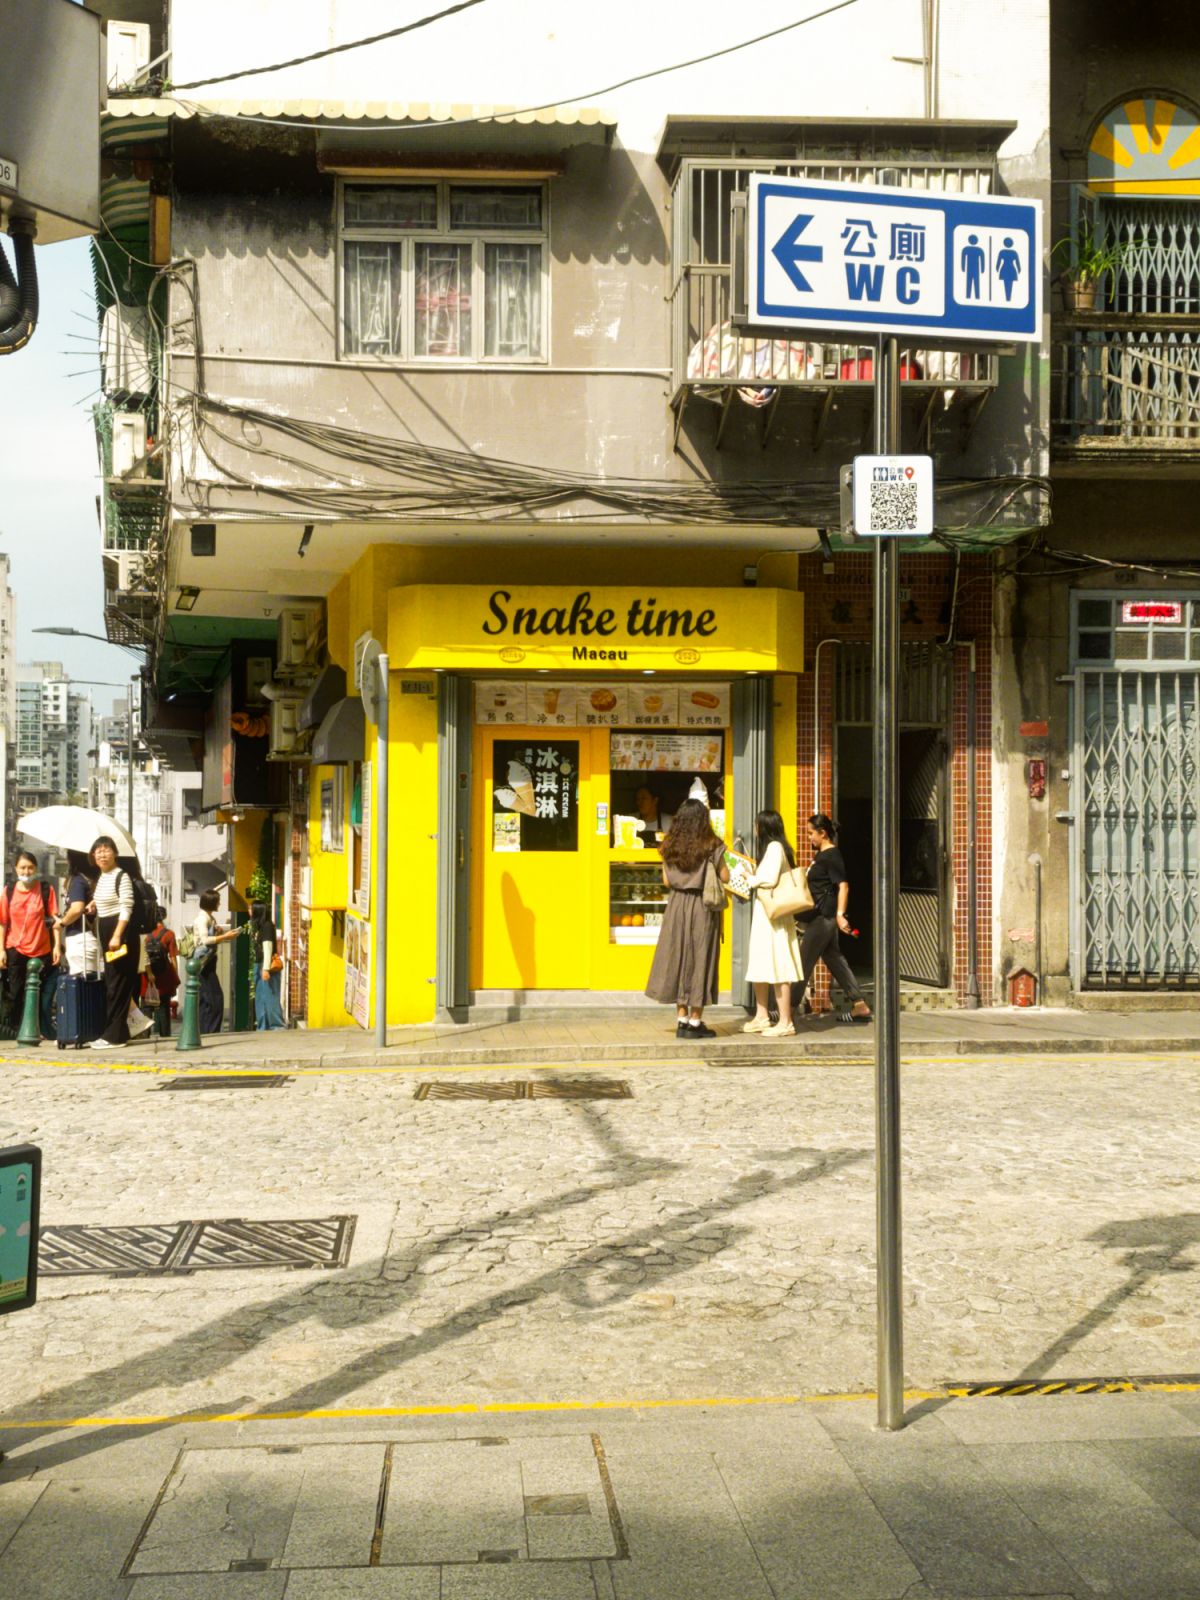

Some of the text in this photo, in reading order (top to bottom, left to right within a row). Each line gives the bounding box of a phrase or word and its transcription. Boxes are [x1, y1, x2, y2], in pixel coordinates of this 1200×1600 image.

[840, 218, 926, 263] 公廁
[844, 262, 921, 305] WC
[482, 590, 718, 637] Snake time
[572, 646, 628, 661] Macau
[536, 747, 559, 819] 冰淇淋
